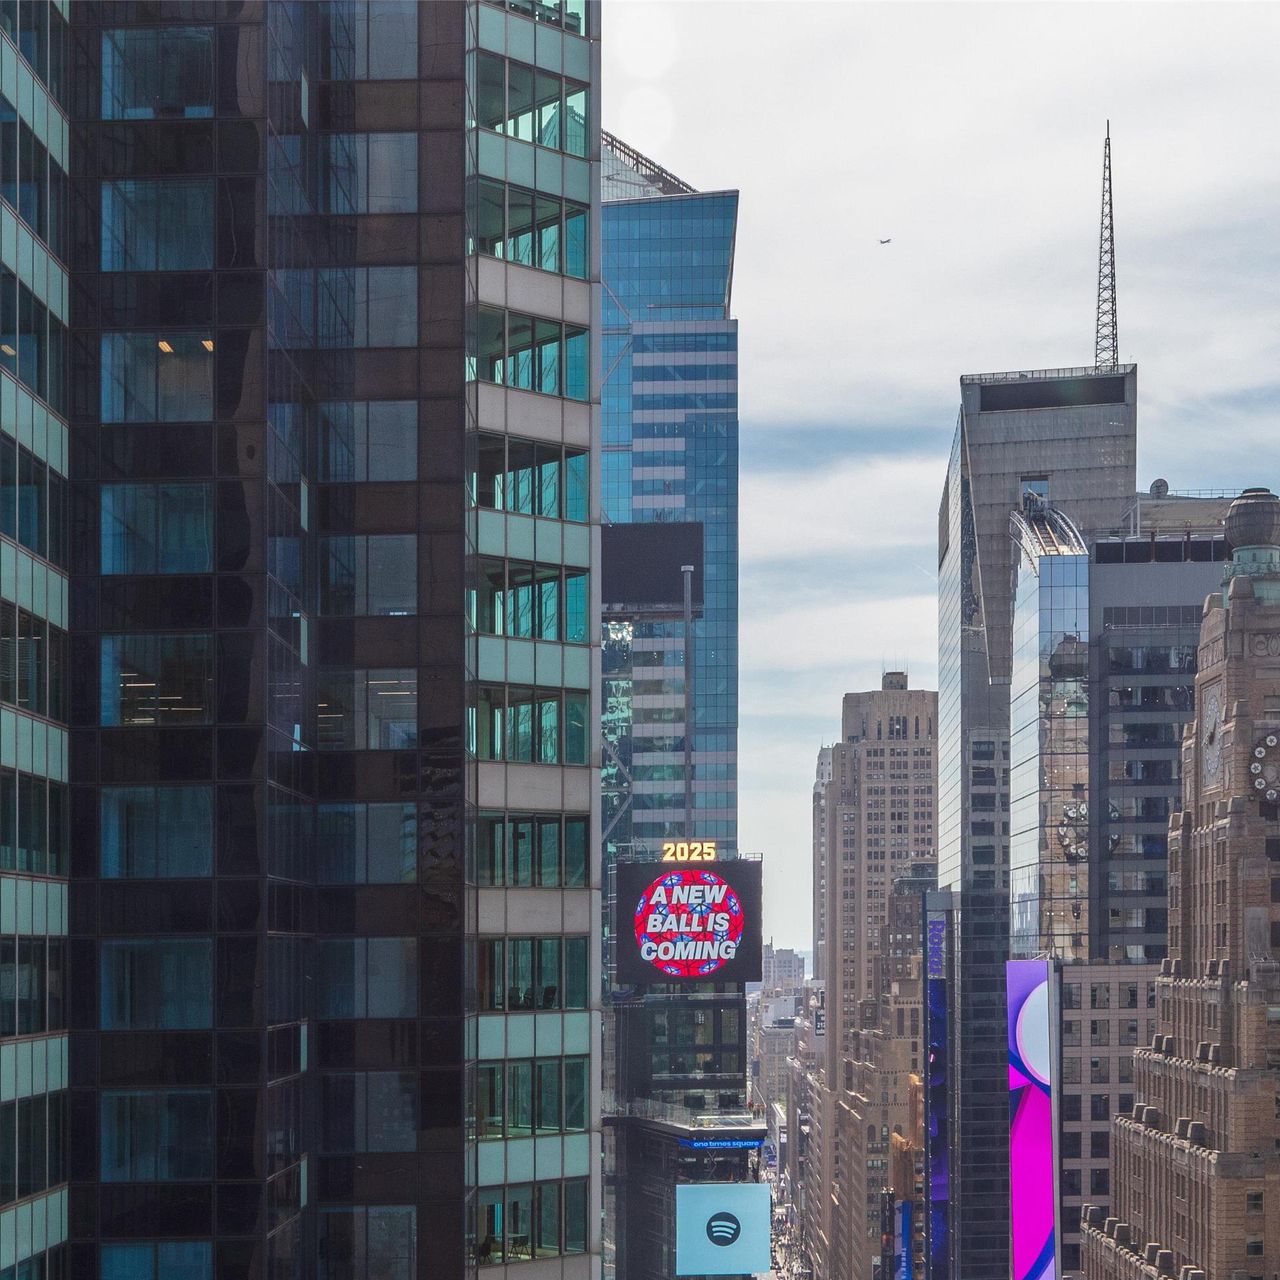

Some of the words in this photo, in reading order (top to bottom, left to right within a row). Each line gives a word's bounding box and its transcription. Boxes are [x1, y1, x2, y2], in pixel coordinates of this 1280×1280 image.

[662, 842, 716, 861] 2025
[650, 886, 667, 905] A
[671, 885, 728, 904] NEW
[647, 914, 703, 932] BALL
[707, 913, 730, 931] IS
[641, 941, 737, 960] COMING
